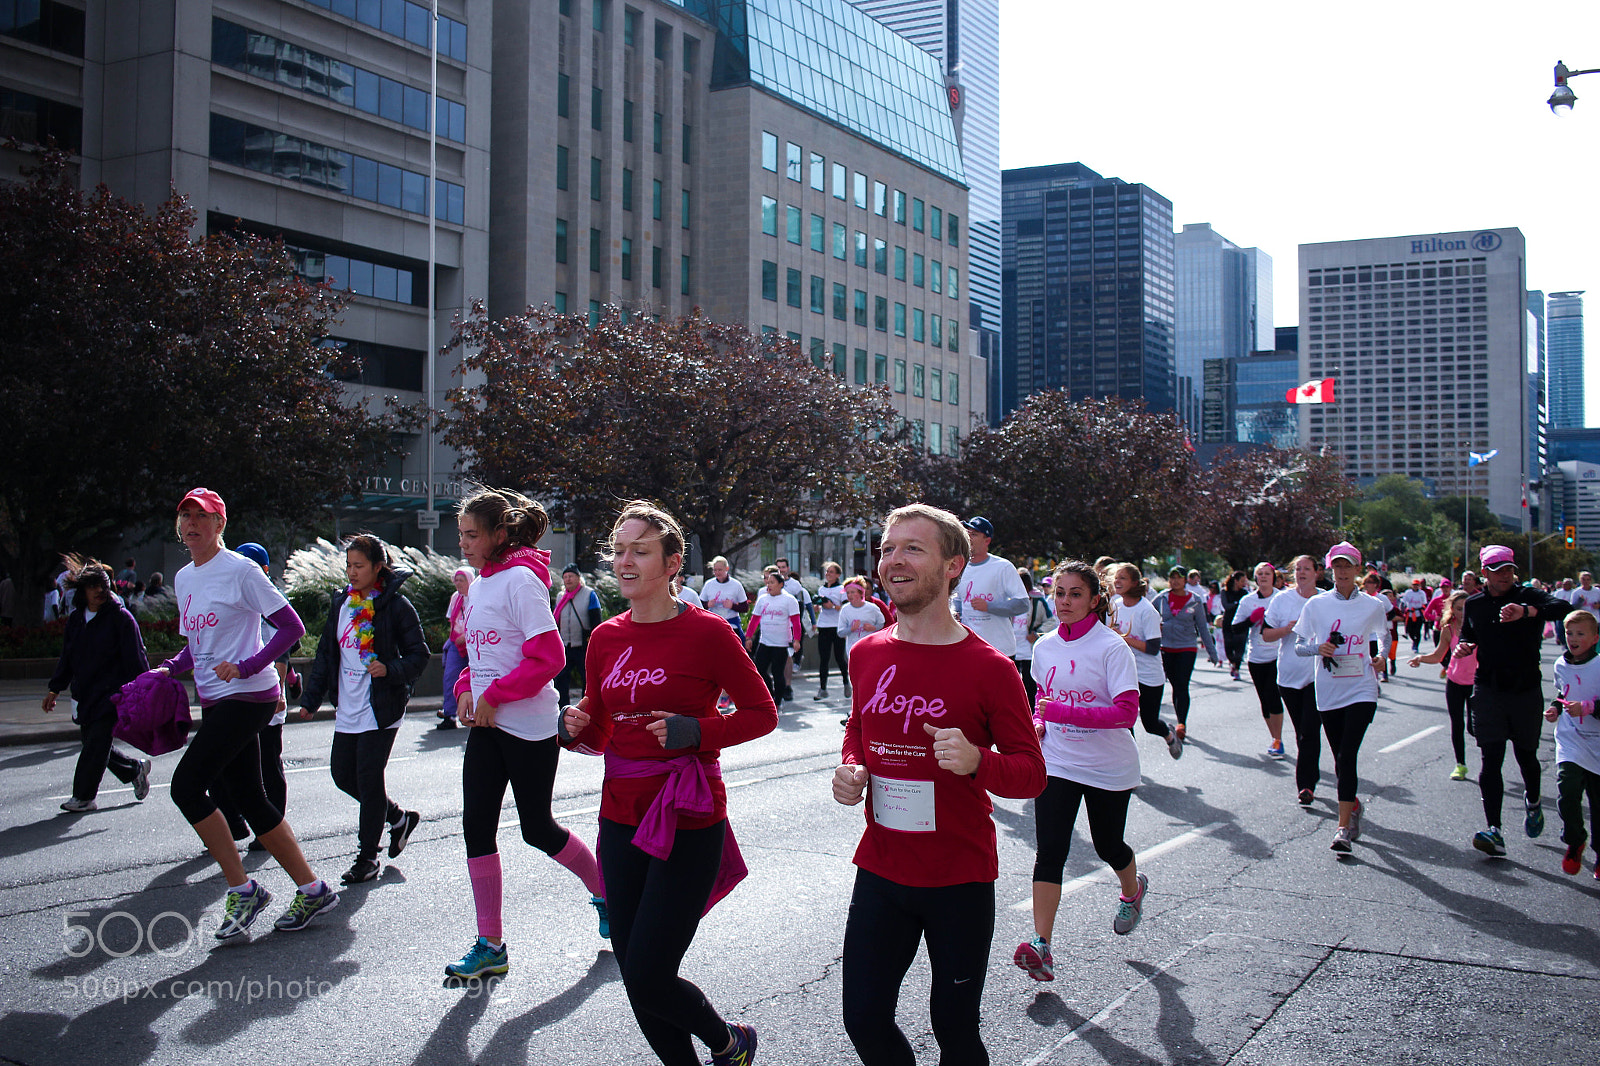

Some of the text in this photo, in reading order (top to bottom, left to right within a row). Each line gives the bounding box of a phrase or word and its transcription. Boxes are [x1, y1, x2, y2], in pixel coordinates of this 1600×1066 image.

[1411, 237, 1467, 253] Hilton
[401, 479, 460, 495] CENTRE
[184, 594, 219, 645] hope
[601, 646, 667, 703] hope
[1041, 666, 1097, 708] hope
[862, 664, 947, 734] hope
